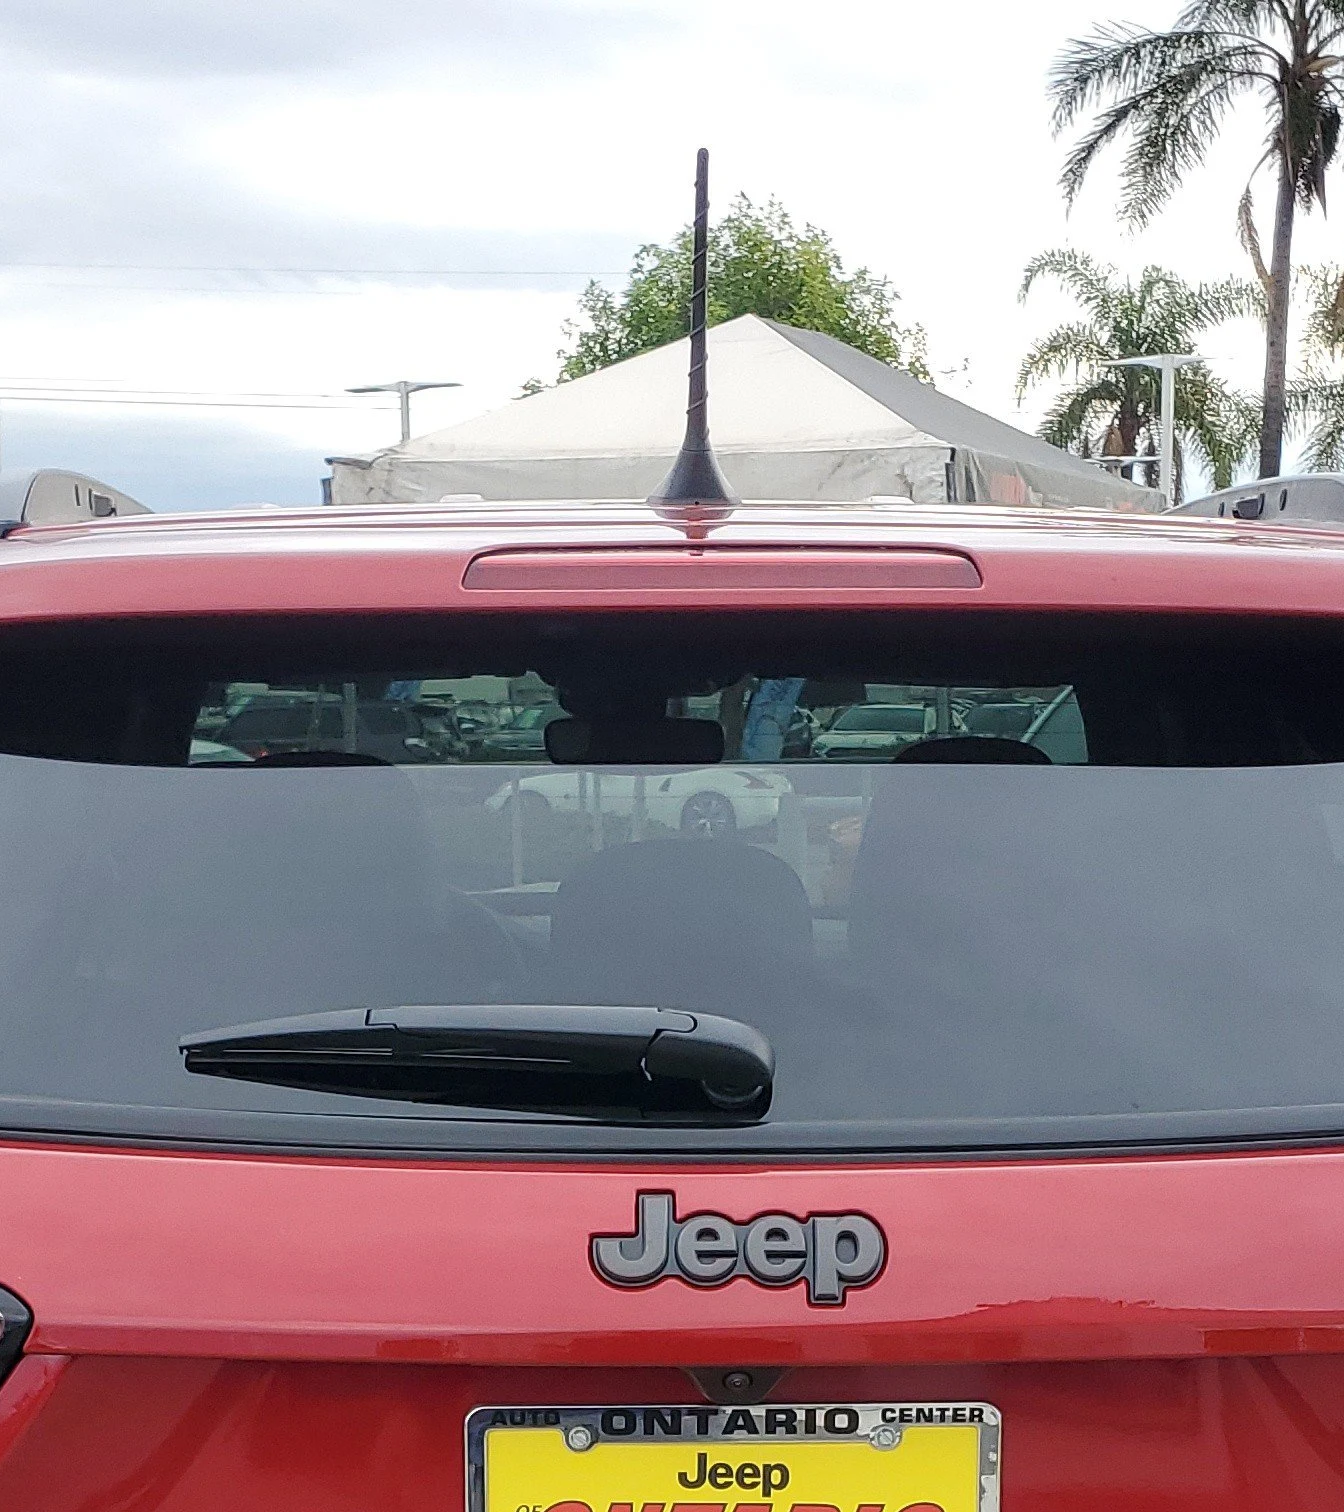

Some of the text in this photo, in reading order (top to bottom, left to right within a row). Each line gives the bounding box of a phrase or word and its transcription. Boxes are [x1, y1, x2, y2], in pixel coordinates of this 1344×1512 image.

[590, 1191, 887, 1307] Jeep
[489, 1406, 985, 1437] AUTO ONTARIO CENTER
[677, 1452, 791, 1498] Jeep
